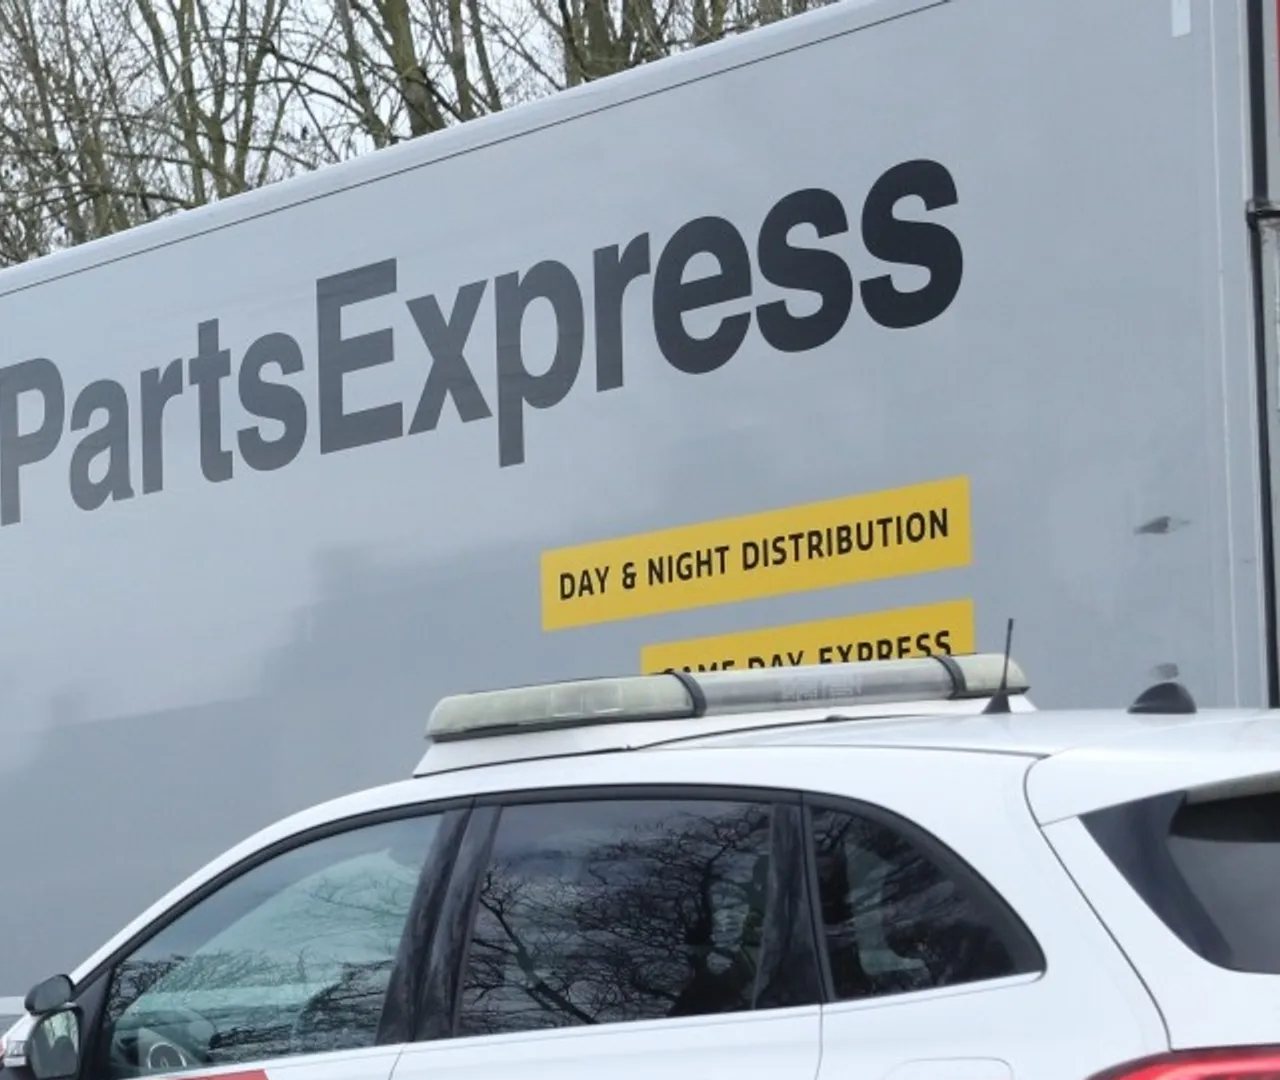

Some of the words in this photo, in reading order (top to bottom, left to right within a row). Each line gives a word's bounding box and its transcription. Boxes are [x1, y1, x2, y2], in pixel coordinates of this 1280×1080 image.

[559, 565, 610, 600] DAY
[621, 561, 638, 590] &
[647, 545, 730, 586] NIGHT
[741, 507, 949, 572] DISTRIBUTION
